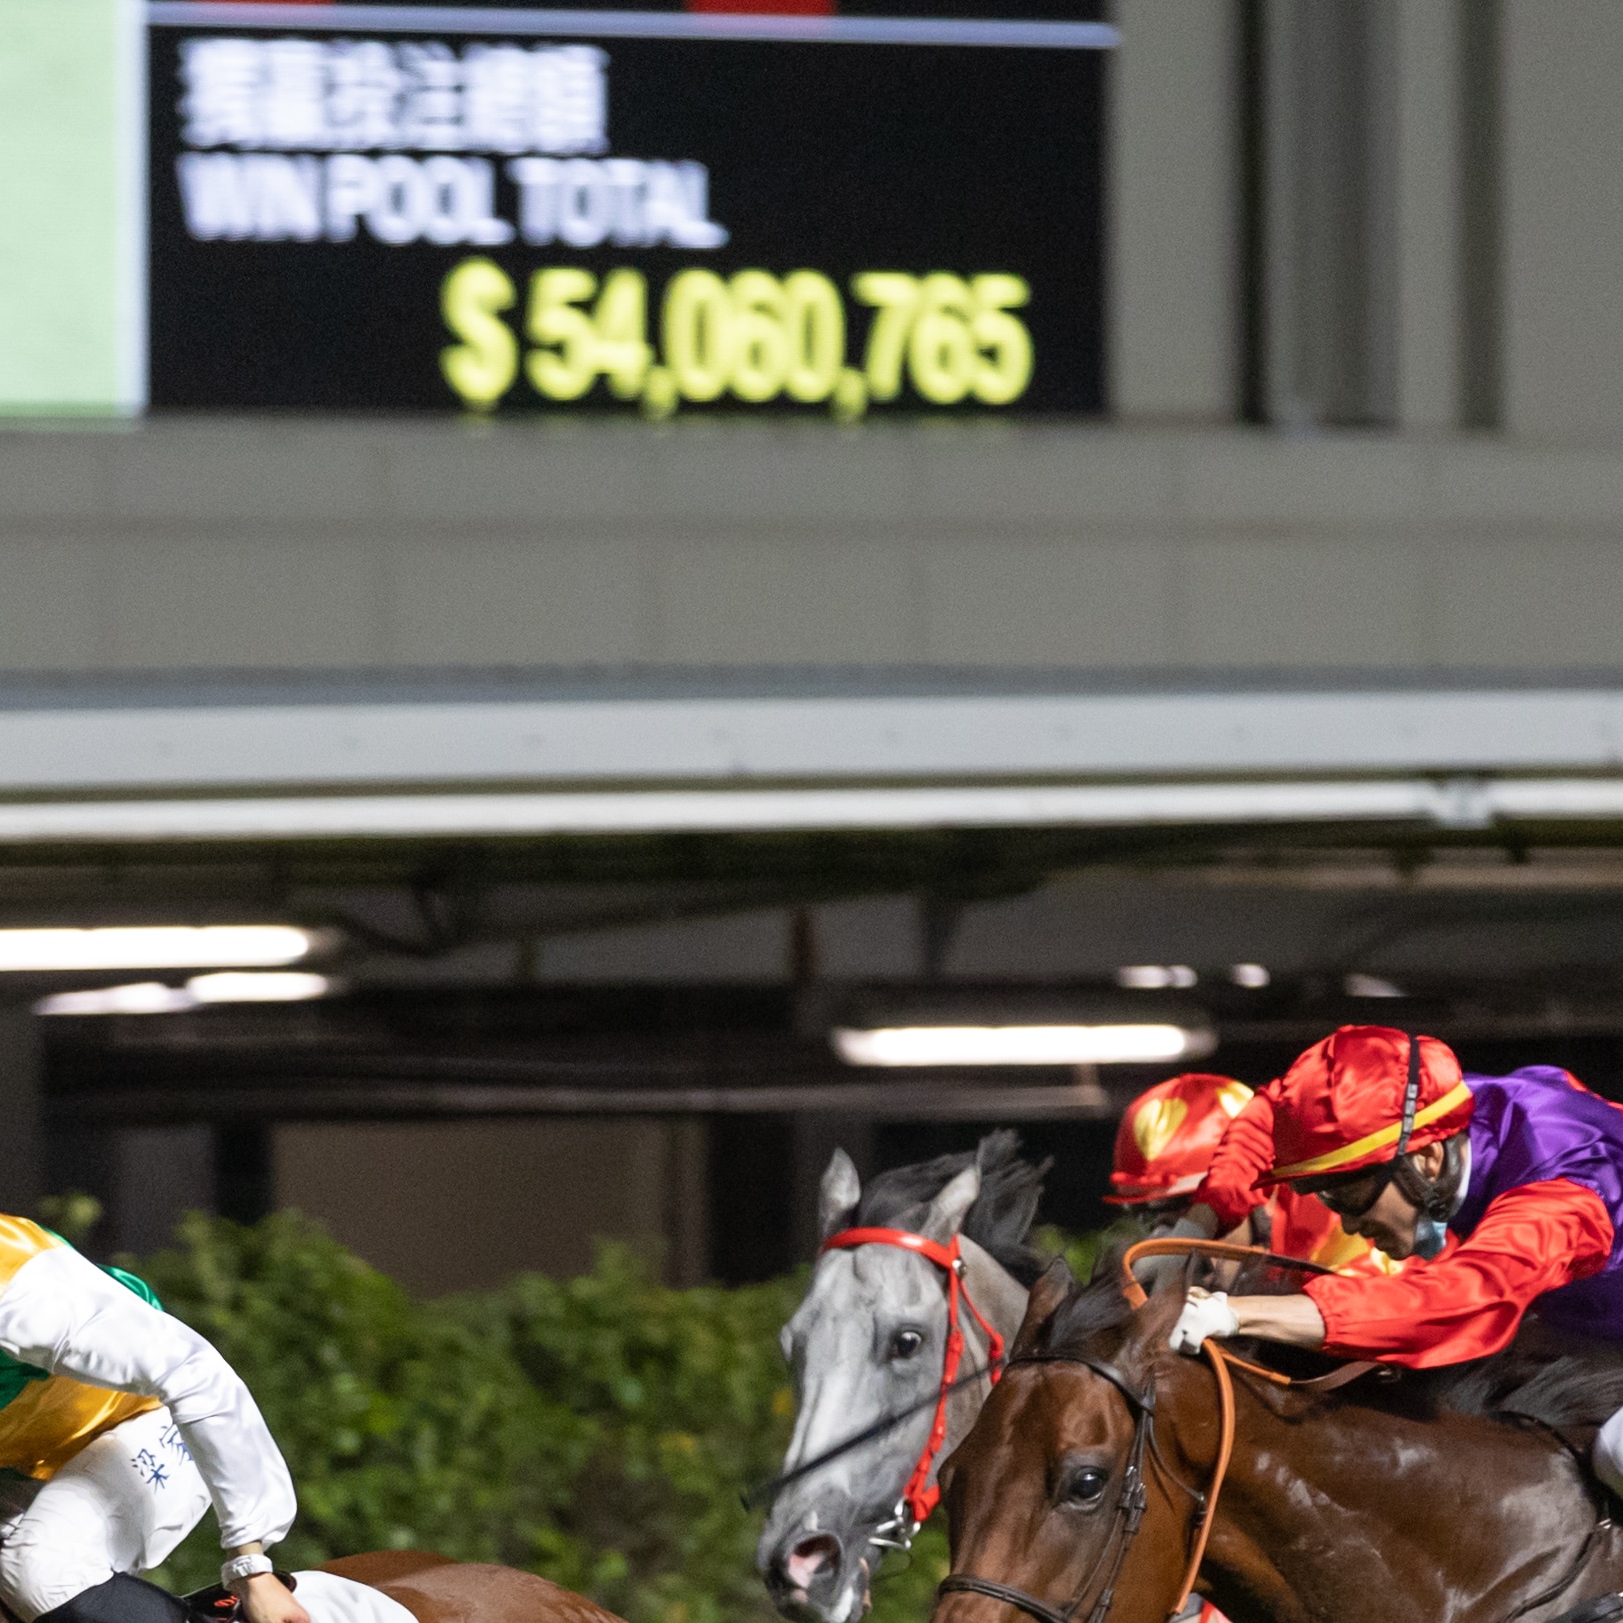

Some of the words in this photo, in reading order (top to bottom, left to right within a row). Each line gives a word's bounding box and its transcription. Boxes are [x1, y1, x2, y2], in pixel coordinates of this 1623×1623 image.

[178, 152, 322, 241] WIN
[326, 153, 515, 245] POOL
[508, 158, 730, 249] TOTAL
